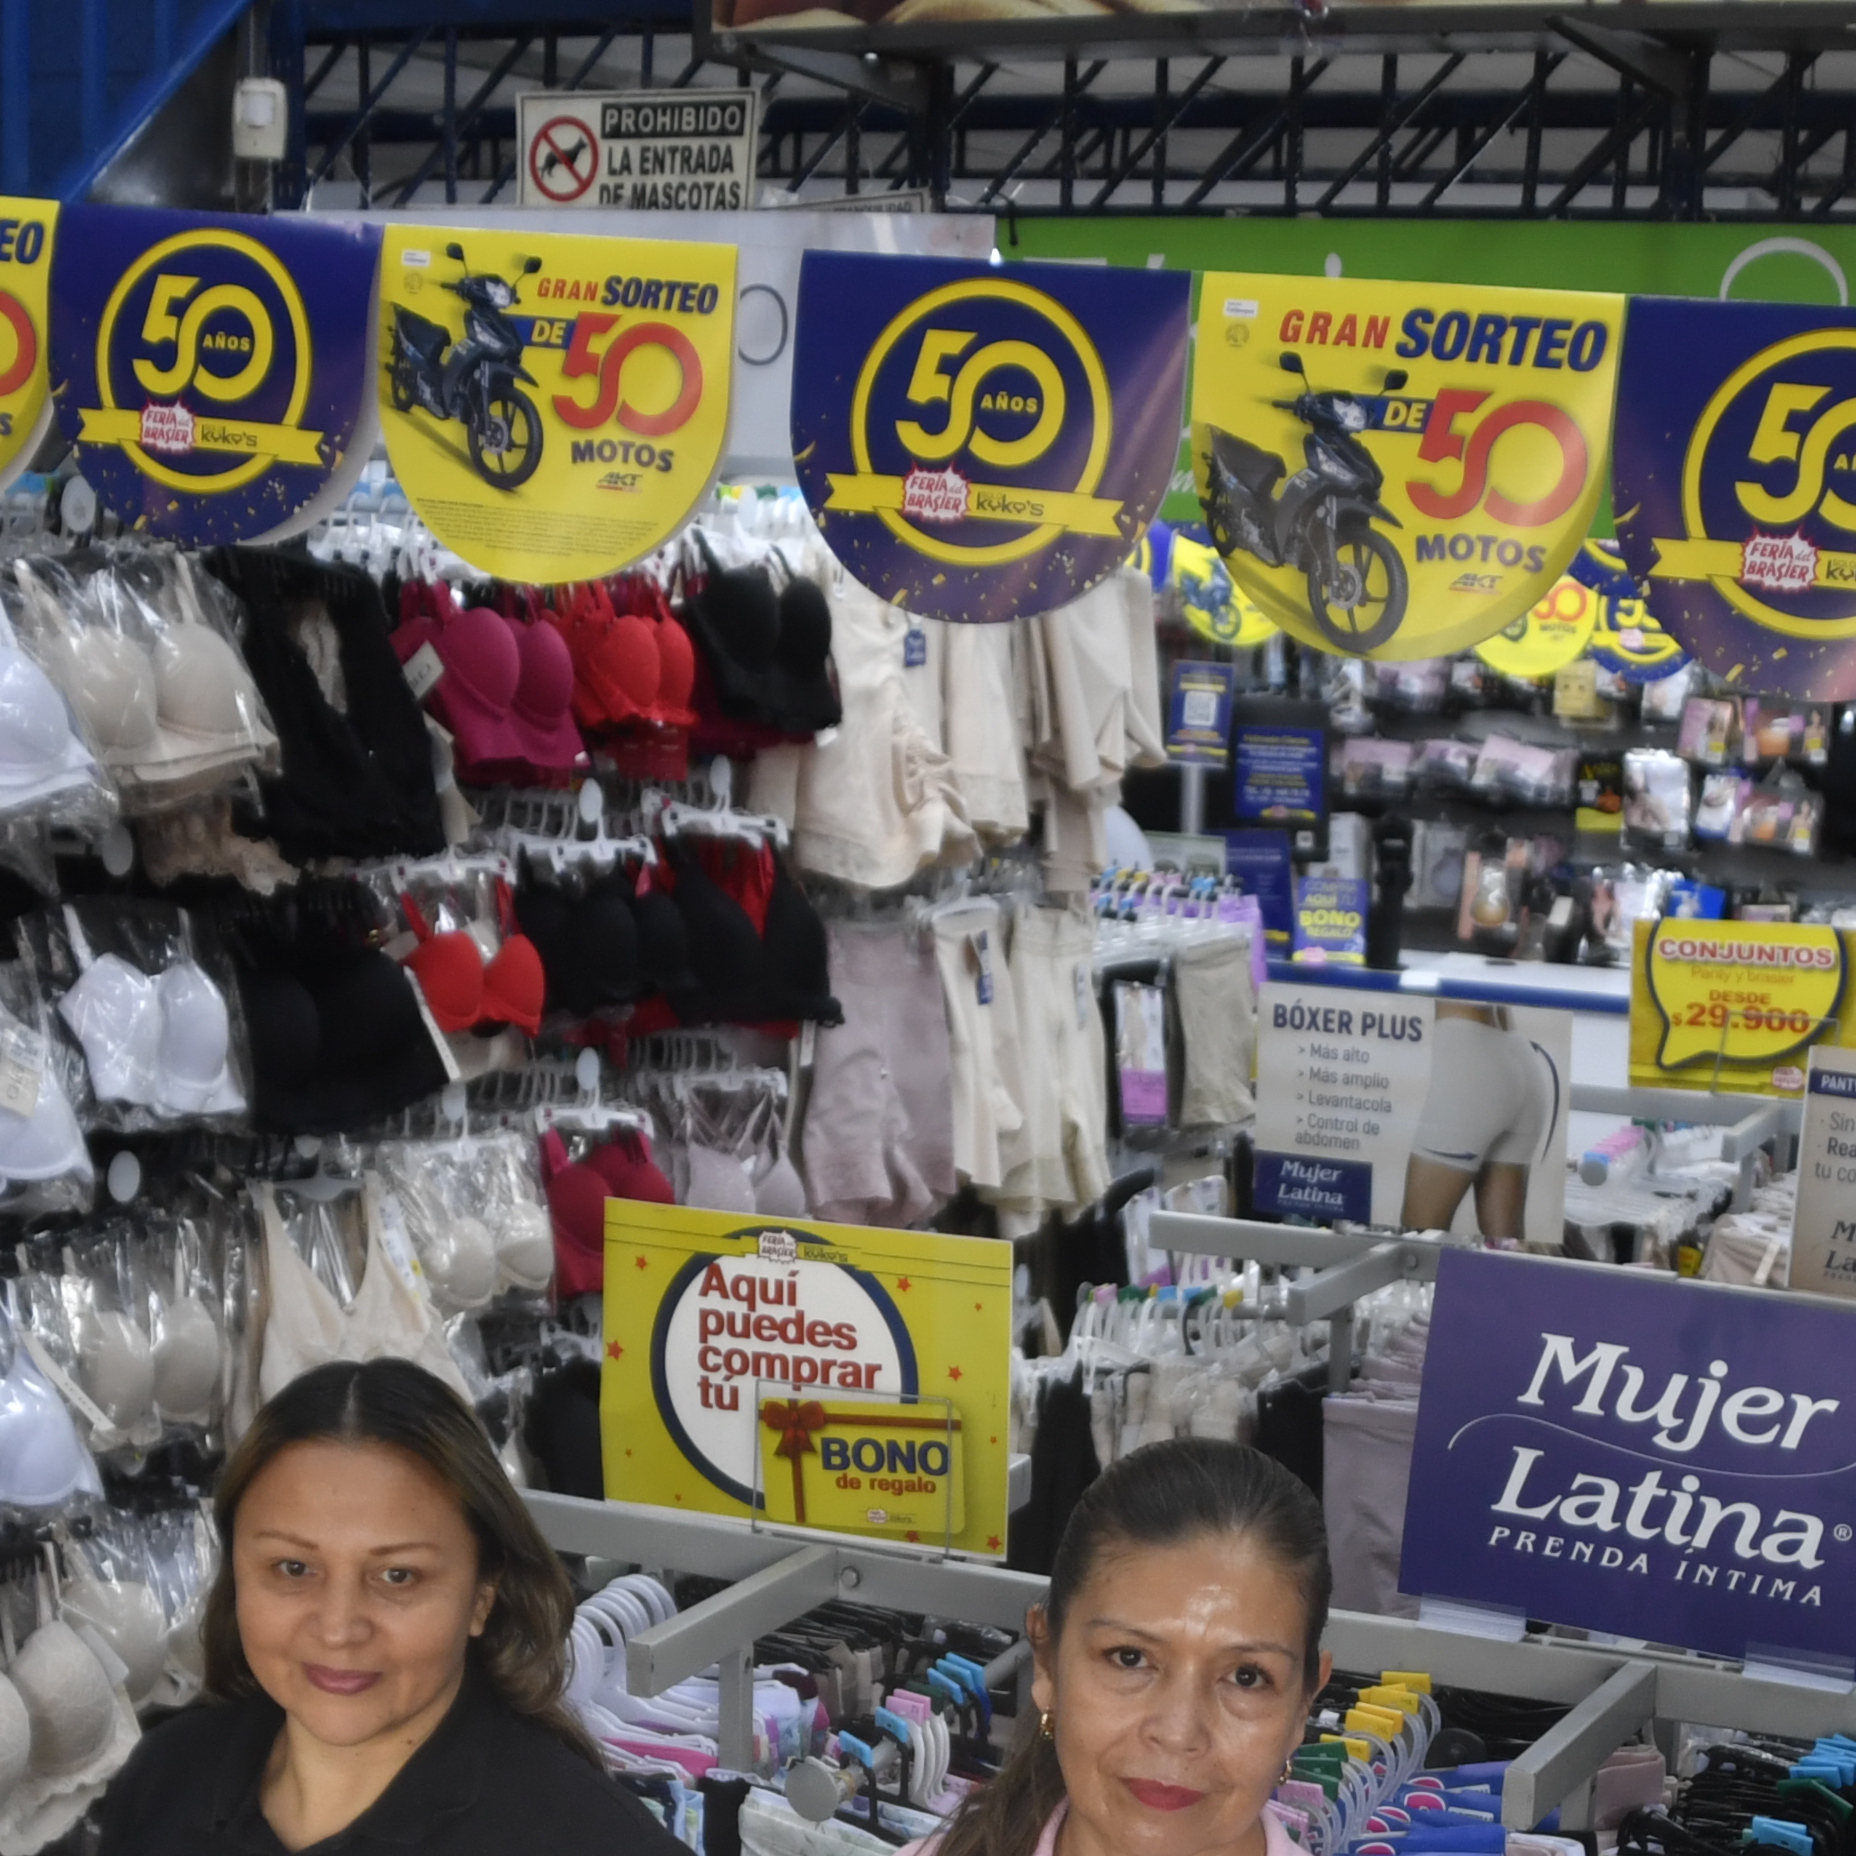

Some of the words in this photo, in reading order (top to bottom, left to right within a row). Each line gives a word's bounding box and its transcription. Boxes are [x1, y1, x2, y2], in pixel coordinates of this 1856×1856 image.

[604, 105, 742, 133] PROHIBIDO
[607, 145, 633, 176] LA
[639, 144, 735, 175] ENTRADA
[599, 182, 623, 205] DE
[630, 181, 741, 210] MASCOTAS
[537, 276, 598, 303] GRAN
[601, 275, 720, 316] SORTEO
[131, 273, 274, 402] 50
[202, 331, 251, 353] AÑOS
[1279, 308, 1391, 349] GRAN
[1395, 307, 1608, 372] SORTEO
[531, 319, 567, 345] DE
[551, 310, 705, 438] 50
[894, 328, 1067, 467] 50
[980, 392, 1038, 413] AÑOS
[570, 440, 676, 474] MOTOS
[1382, 402, 1425, 428] DE
[1405, 387, 1589, 528] 50
[907, 493, 963, 514] BRASIER
[1416, 534, 1548, 574] MOTOS
[1746, 560, 1810, 582] BRASIER
[1657, 938, 1835, 968] CONJUNTOS
[1690, 964, 1729, 985] Panty
[1746, 968, 1796, 986] brasier
[1708, 988, 1771, 1006] DESDE
[1272, 998, 1353, 1035] BÓXER
[1361, 1012, 1423, 1042] PLUS
[1310, 1043, 1339, 1061] Más
[1342, 1045, 1370, 1064] alto
[1309, 1066, 1339, 1085] Más
[1341, 1069, 1390, 1090] amplio
[1307, 1090, 1393, 1114] Levantacola
[1307, 1113, 1357, 1136] Control
[1361, 1119, 1381, 1137] de
[1829, 1111, 1856, 1134] Sin
[1295, 1131, 1361, 1151] abdomen
[1280, 1159, 1343, 1183] Mujer
[1814, 1161, 1834, 1182] tu
[1277, 1182, 1344, 1206] Latina
[698, 1262, 799, 1313] Aquí
[697, 1307, 858, 1351] puedes
[696, 1344, 883, 1392] comprar
[697, 1373, 740, 1412] tú
[1516, 1332, 1840, 1452] Mujer
[820, 1436, 949, 1477] BONO
[835, 1473, 862, 1492] de
[869, 1475, 937, 1497] regalo
[1489, 1445, 1826, 1570] Latina
[1487, 1525, 1649, 1575] PRENDA
[1674, 1546, 1824, 1607] ÍNTIMA
